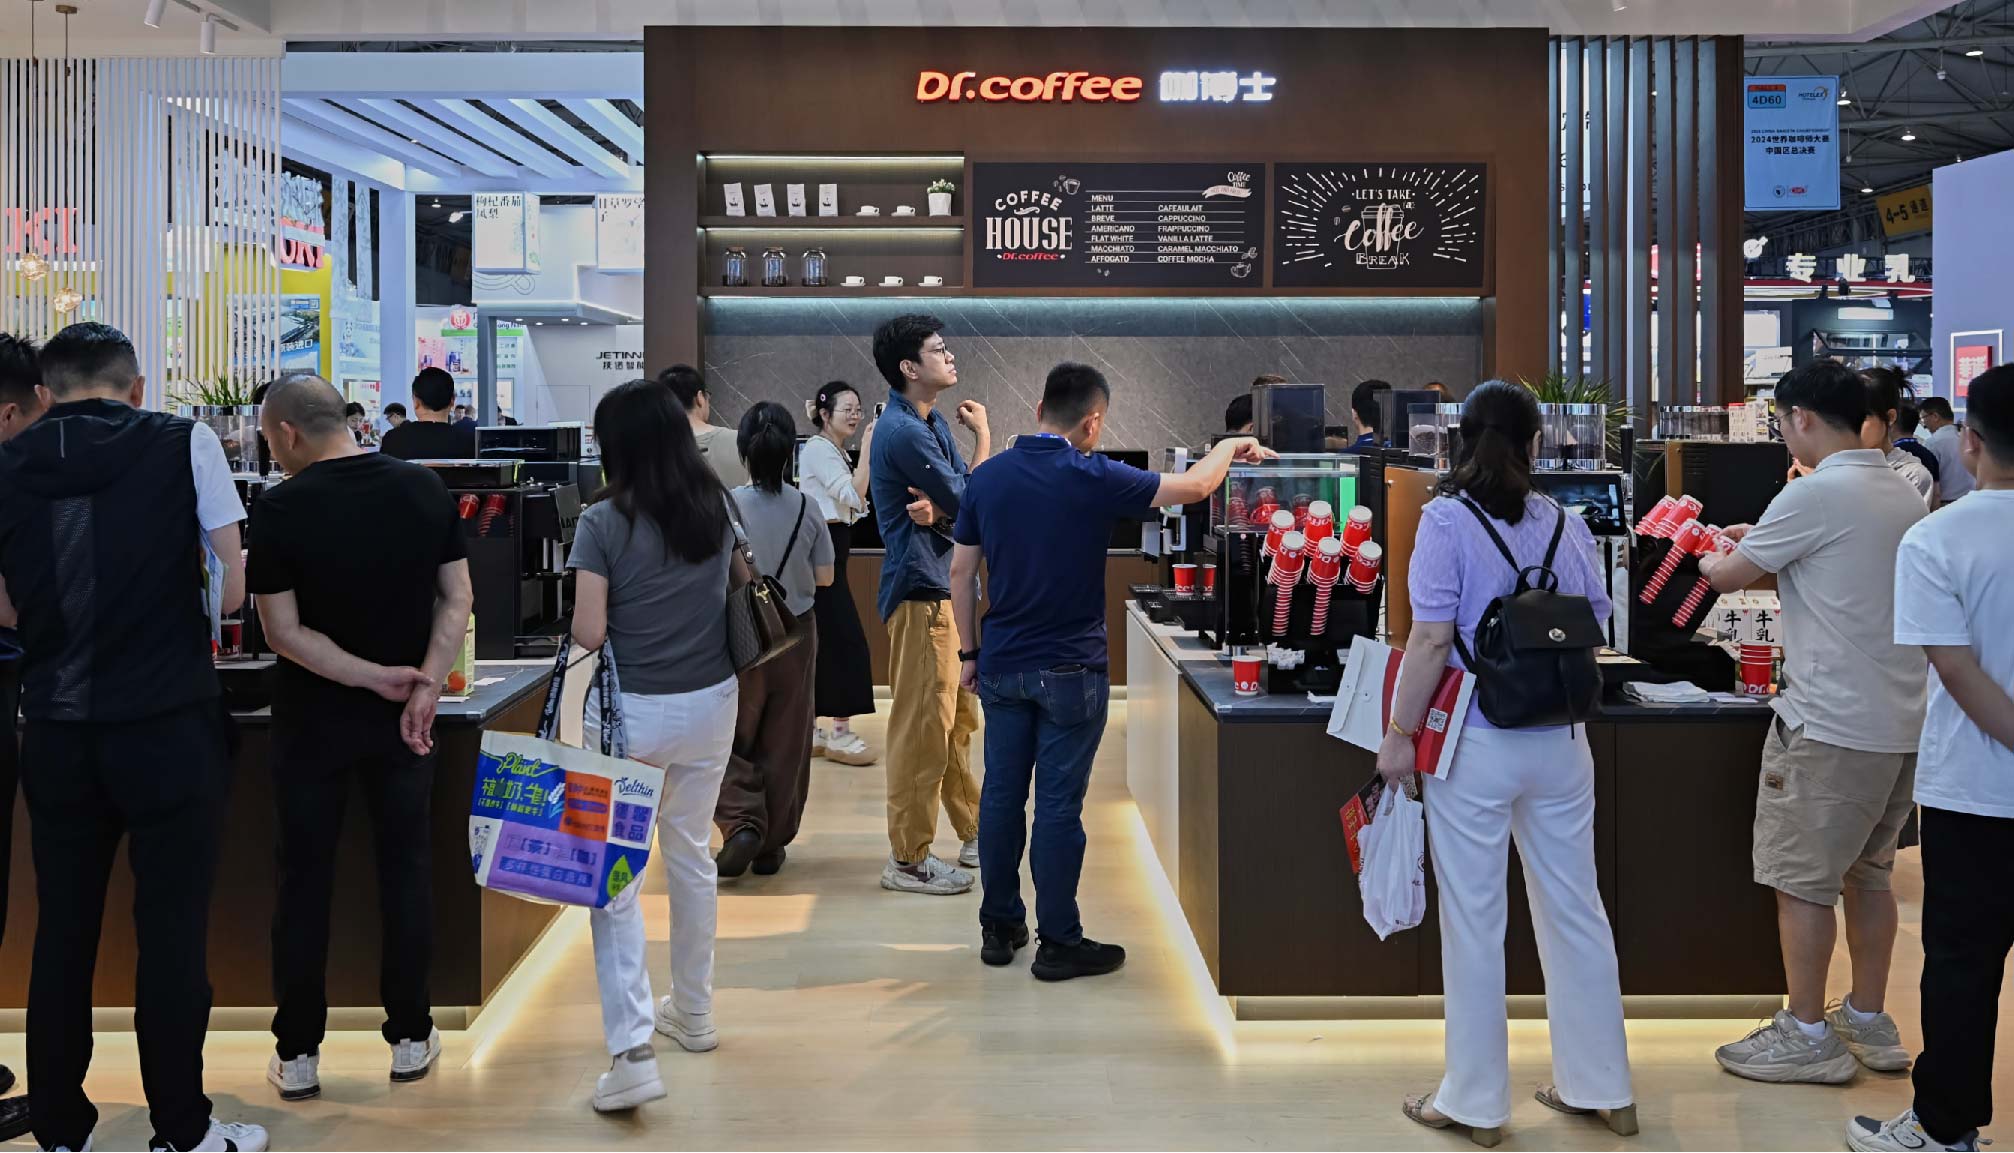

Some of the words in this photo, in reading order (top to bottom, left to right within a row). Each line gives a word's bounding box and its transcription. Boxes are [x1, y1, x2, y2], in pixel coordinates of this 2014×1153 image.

[916, 71, 1143, 101] Dr.coffee
[1159, 71, 1277, 102] 咖博士
[1752, 95, 1782, 105] 4D60
[1765, 146, 1816, 155] 中国区总决赛
[995, 190, 1063, 212] COFFEE
[1355, 189, 1383, 200] LET'S
[1387, 189, 1412, 200] TAKE
[1886, 204, 1909, 224] 4-5
[985, 217, 1073, 250] HOUSE
[1002, 252, 1059, 261] Dr.coffee
[1158, 255, 1186, 263] COFFEE
[1187, 255, 1215, 263] MOCHA
[1355, 252, 1410, 265] BREAK
[1786, 252, 1916, 284] 专业乳
[596, 351, 644, 360] JETINN
[1755, 609, 1775, 643] 牛乳
